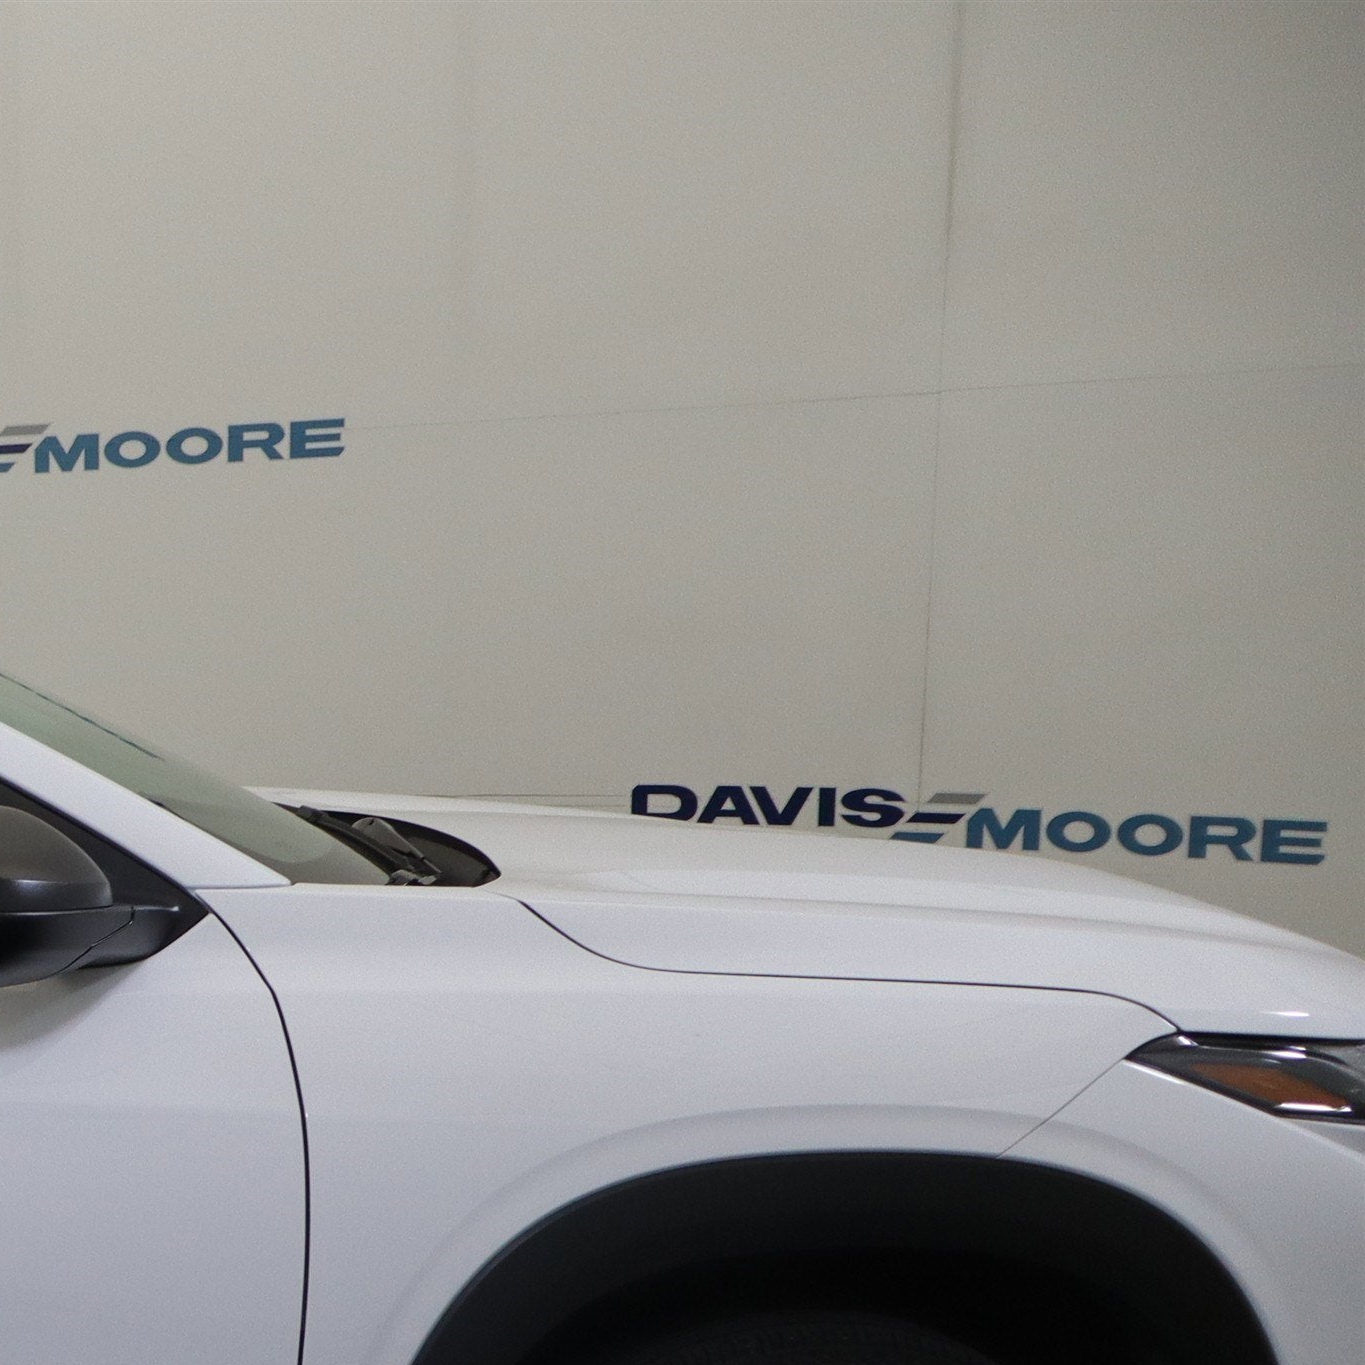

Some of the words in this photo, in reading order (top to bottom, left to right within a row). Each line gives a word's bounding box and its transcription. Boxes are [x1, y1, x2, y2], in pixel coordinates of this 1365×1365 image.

[34, 418, 345, 473] MOORE
[631, 784, 906, 828] DAVIS
[966, 807, 1327, 865] MOORE
